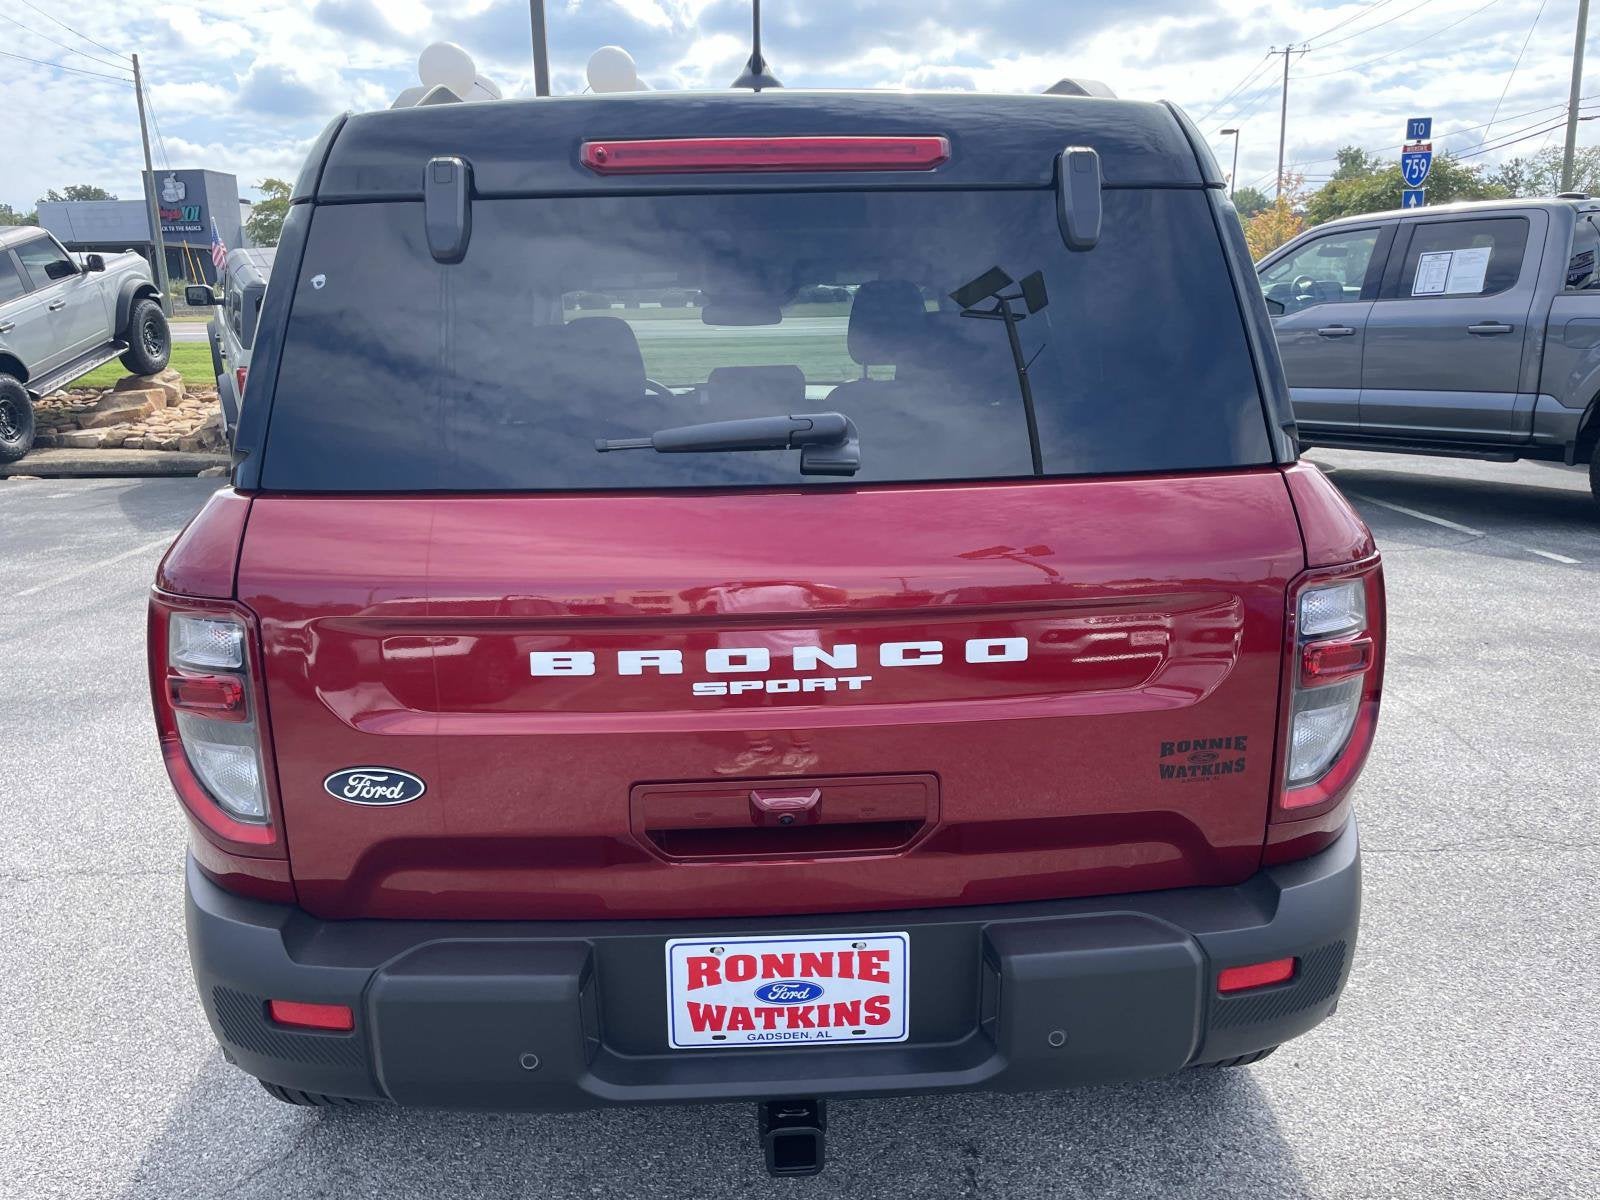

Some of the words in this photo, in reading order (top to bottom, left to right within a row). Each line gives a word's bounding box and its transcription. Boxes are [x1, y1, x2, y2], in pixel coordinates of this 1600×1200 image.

[1413, 122, 1424, 135] TO
[1405, 158, 1427, 179] 759
[179, 206, 200, 221] 101
[529, 637, 1029, 676] BRONCO
[692, 675, 873, 696] SPORT
[1160, 735, 1248, 758] RONNIE
[1159, 757, 1246, 779] WATKINS
[343, 773, 405, 799] Ford
[686, 950, 890, 991] RONNIE
[767, 983, 810, 1001] Ford
[686, 995, 892, 1033] WATKINS
[747, 1031, 813, 1042] GADSDEN,
[816, 1030, 833, 1039] AL
